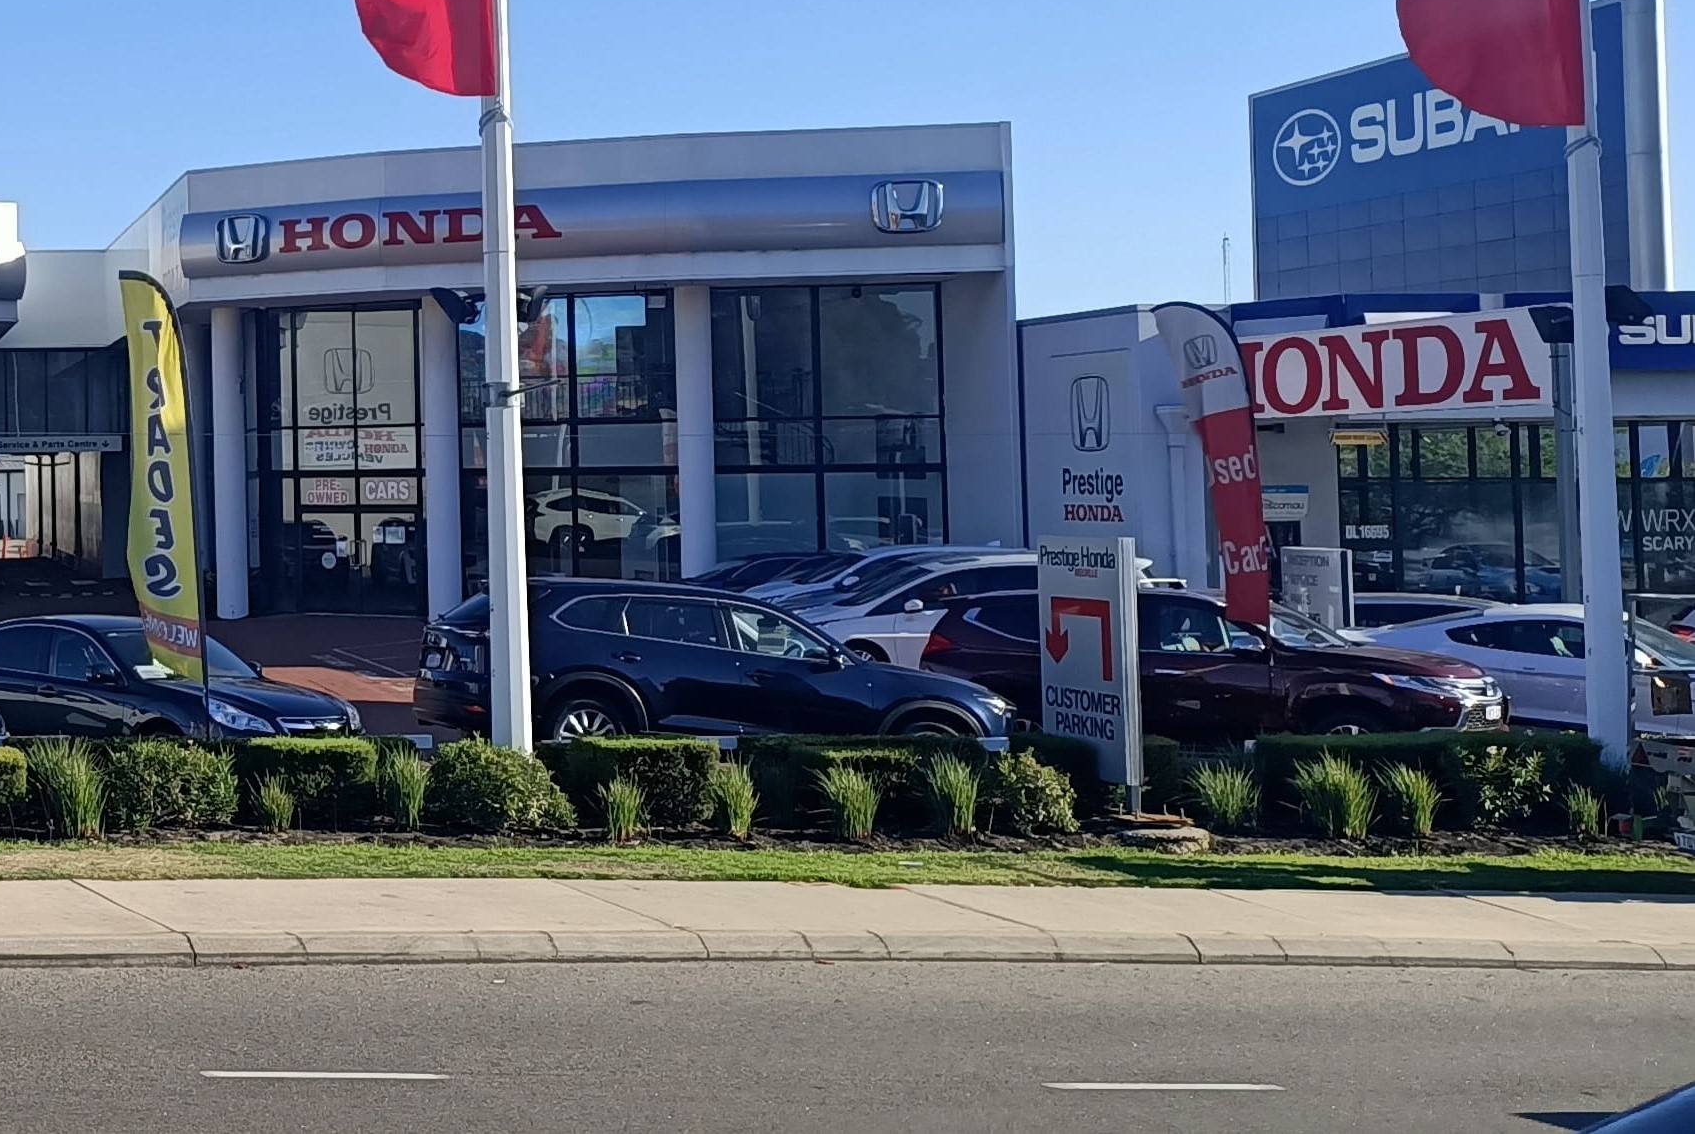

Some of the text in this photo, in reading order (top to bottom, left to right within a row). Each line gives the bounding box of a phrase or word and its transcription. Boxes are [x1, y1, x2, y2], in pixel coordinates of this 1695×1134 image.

[1350, 88, 1520, 163] SUB
[278, 204, 562, 253] HONDA
[1618, 314, 1695, 345] SU
[364, 443, 410, 454] HONDA
[307, 491, 348, 504] OWNED
[364, 480, 411, 502] CARS
[1062, 467, 1124, 503] Prestige
[1063, 504, 1125, 522] HONDA
[1641, 509, 1695, 532] WRX
[1642, 535, 1695, 552] SCARY
[1039, 544, 1116, 572] Prestige Honda
[1045, 685, 1121, 716] CUSTOMER
[1055, 711, 1115, 741] PARKING
